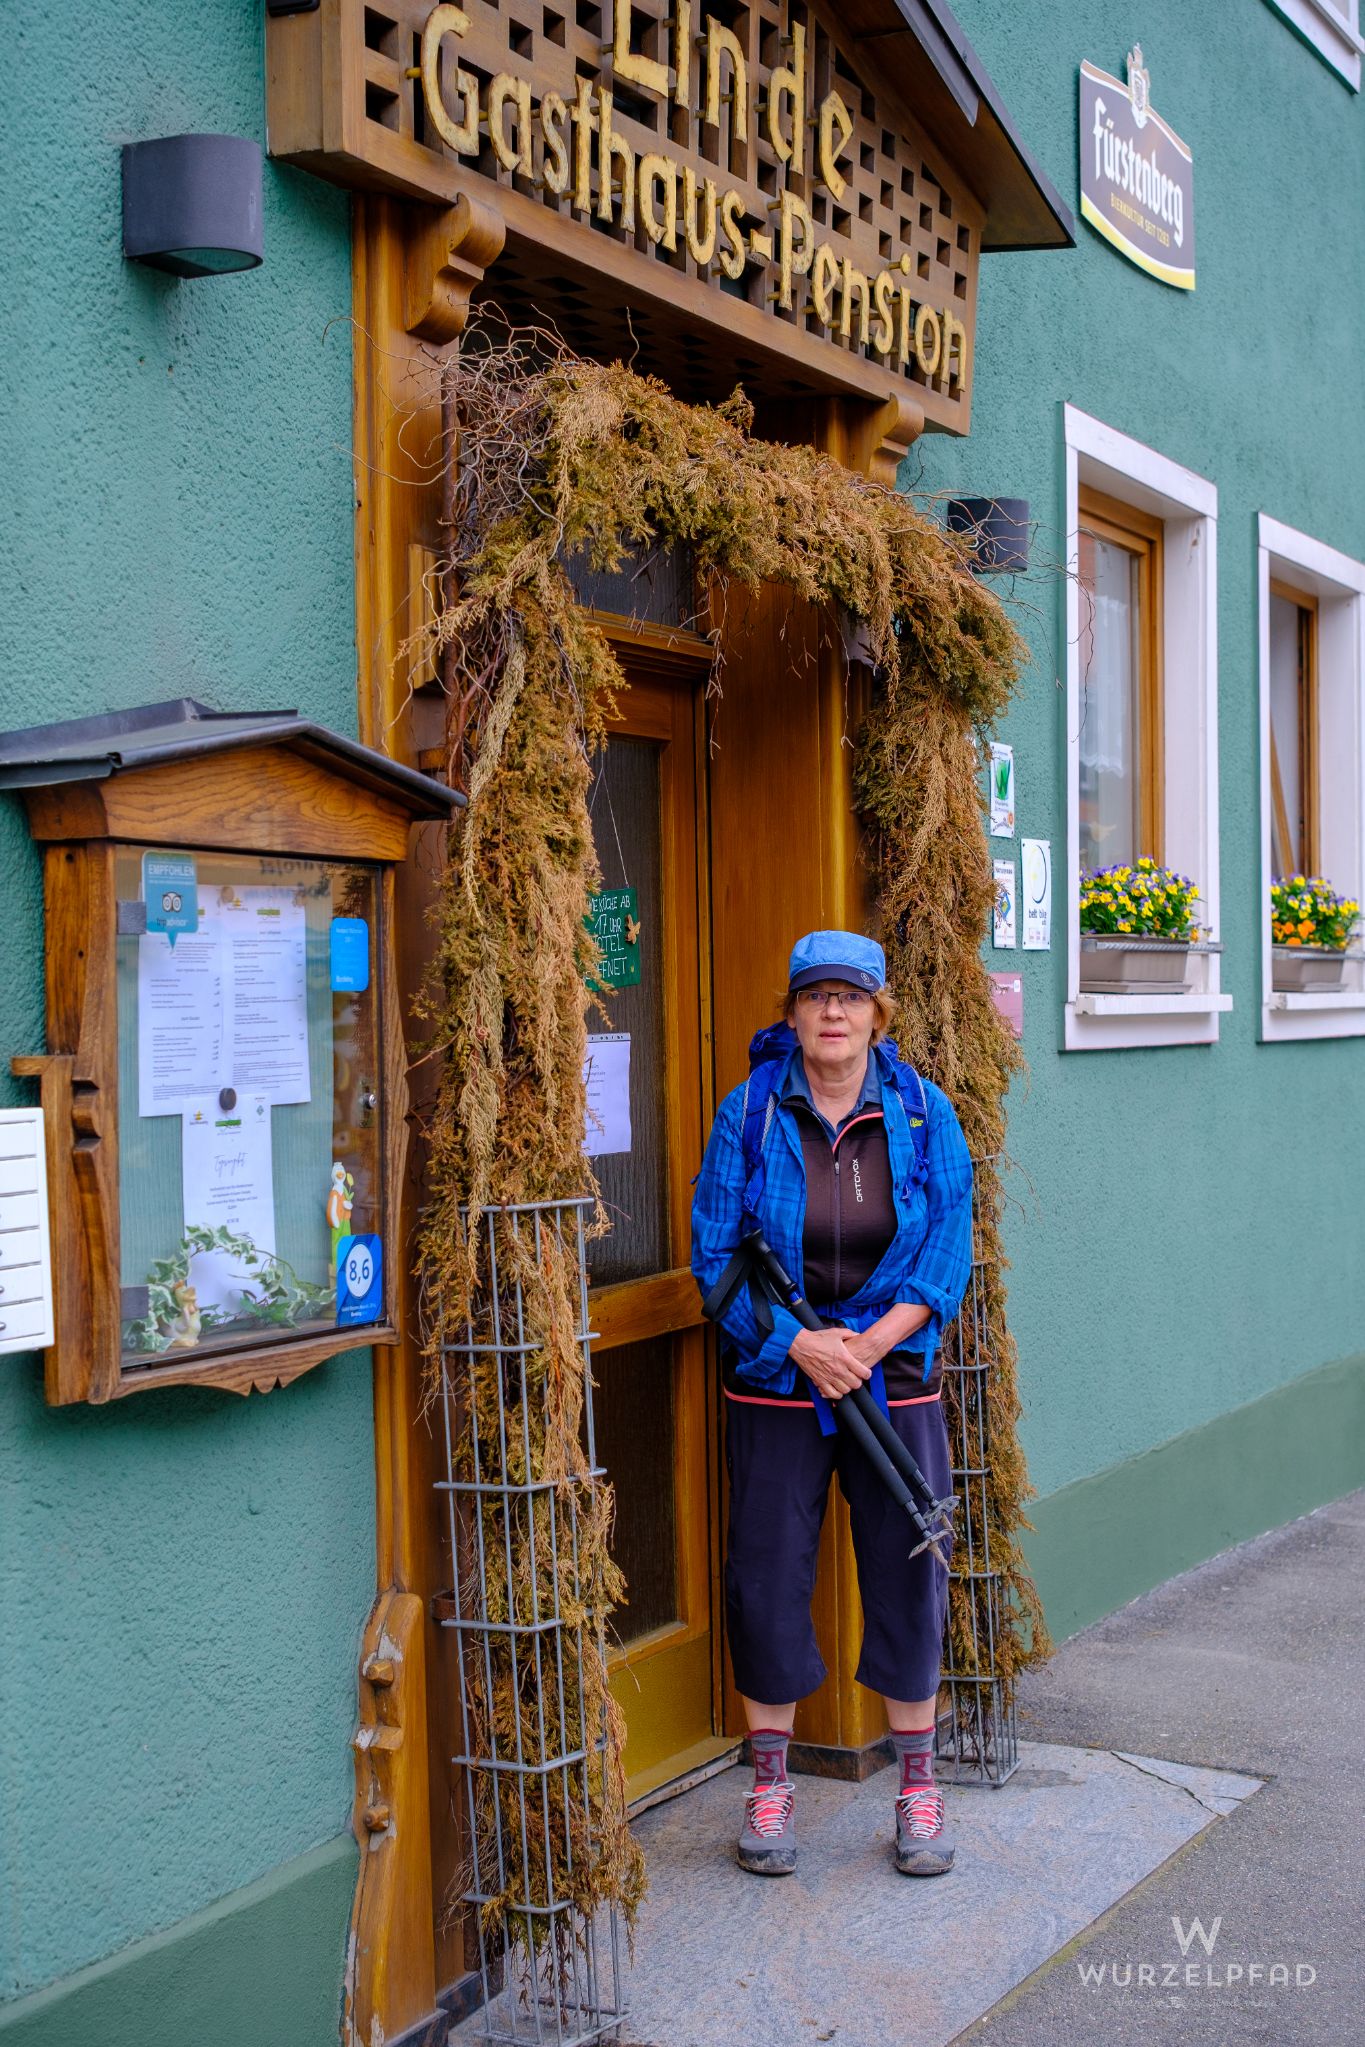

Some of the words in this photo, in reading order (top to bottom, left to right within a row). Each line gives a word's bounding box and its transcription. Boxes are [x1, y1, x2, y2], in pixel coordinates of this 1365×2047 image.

[421, 3, 967, 391] Gasthaus-Pension
[148, 864, 194, 876] EMPFOHLEN
[600, 895, 617, 912] KÜCHE
[620, 895, 631, 908] AB
[595, 914, 607, 934] 17
[609, 917, 622, 933] UHR
[853, 1158, 863, 1203] ORTOVOX
[350, 1258, 370, 1285] 8,6
